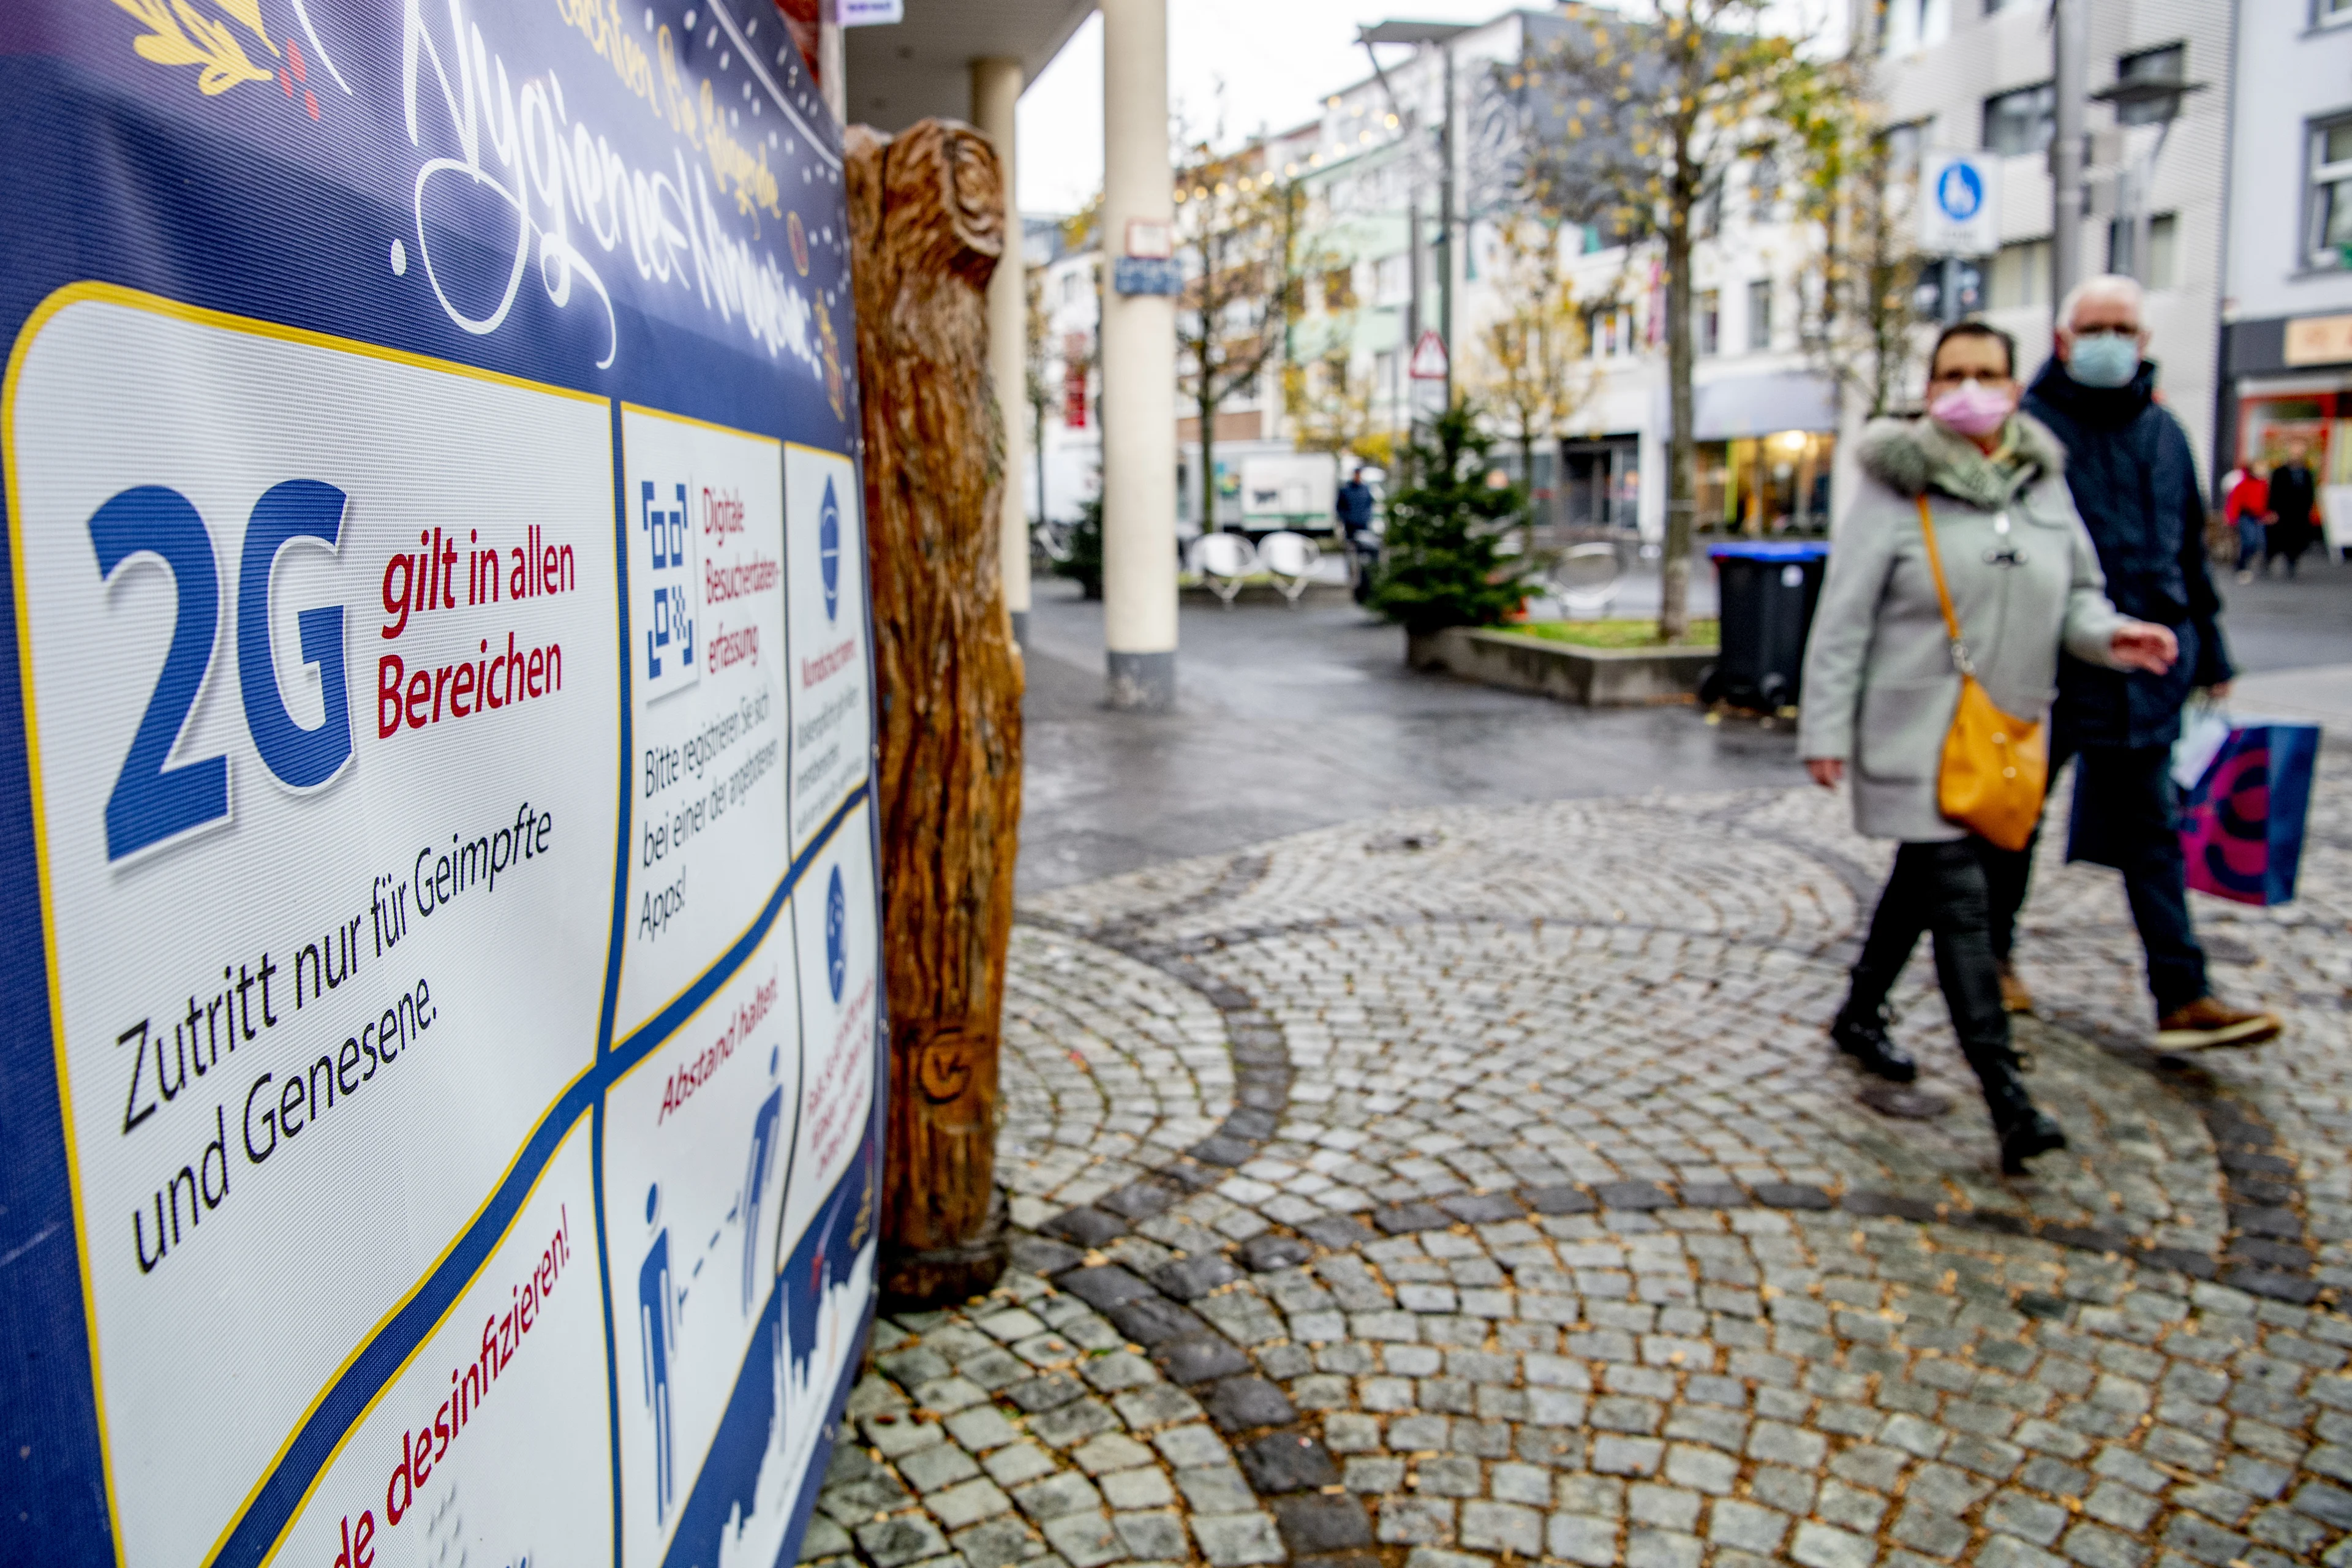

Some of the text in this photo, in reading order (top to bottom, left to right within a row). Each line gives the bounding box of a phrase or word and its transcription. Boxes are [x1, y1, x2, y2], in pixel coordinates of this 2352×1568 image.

[703, 484, 745, 548] Digitale
[381, 524, 575, 639] gilt in allen
[87, 478, 354, 862] 2G
[377, 631, 562, 739] Bereichen
[707, 622, 760, 675] erfassung
[645, 745, 679, 799] Bitte
[682, 713, 739, 780] registrieren
[739, 694, 754, 735] Sie
[754, 686, 770, 725] sich
[643, 810, 669, 870] bei
[673, 797, 707, 848] einer
[709, 774, 728, 822] der
[638, 864, 686, 943] Apps!
[116, 802, 552, 1136] Zutritt nur für Geimpfte
[658, 962, 778, 1128] Abstand halten!
[131, 978, 437, 1275] und Genesene.
[386, 1202, 570, 1526] desinfizieren!
